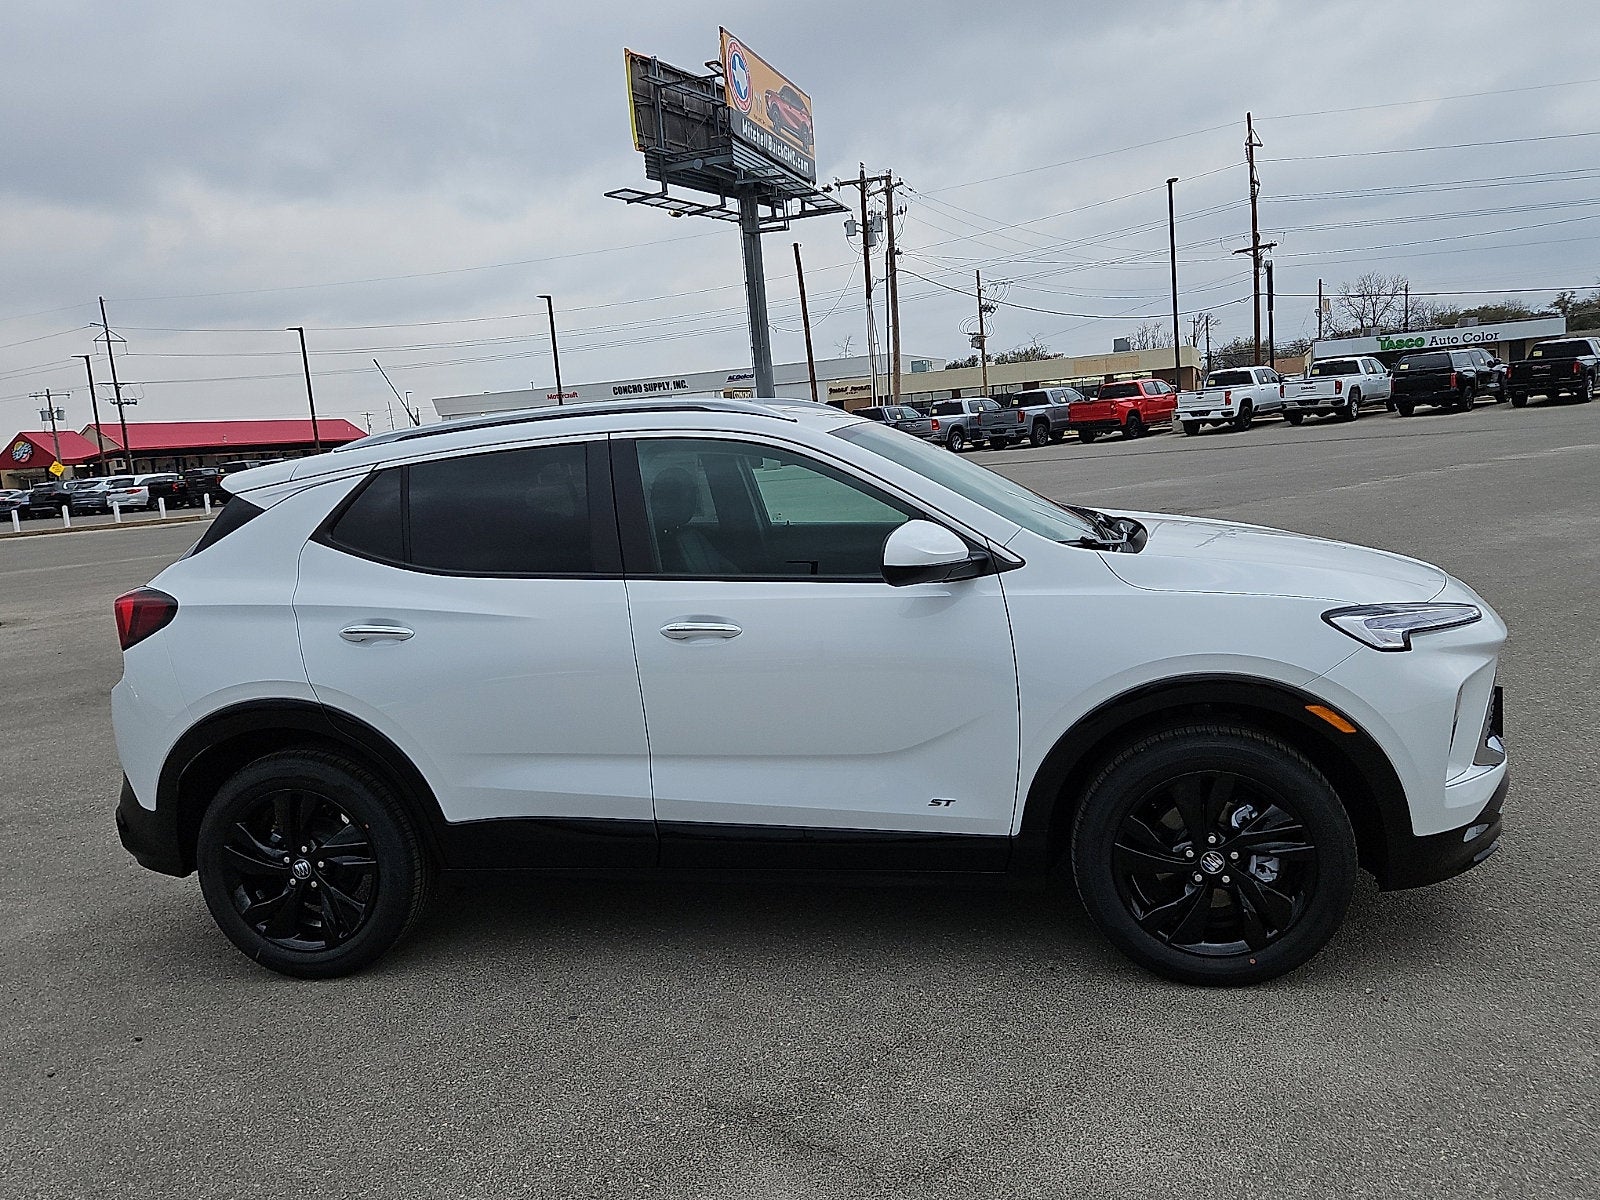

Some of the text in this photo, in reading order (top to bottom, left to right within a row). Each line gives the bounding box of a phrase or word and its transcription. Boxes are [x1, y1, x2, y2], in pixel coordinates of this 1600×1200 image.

[1428, 335, 1459, 347] Auto
[1462, 331, 1500, 343] Color
[612, 379, 689, 396] CONCHO SUPPLY, INC.
[546, 391, 578, 400] Motrcraft
[928, 798, 957, 807] ST
